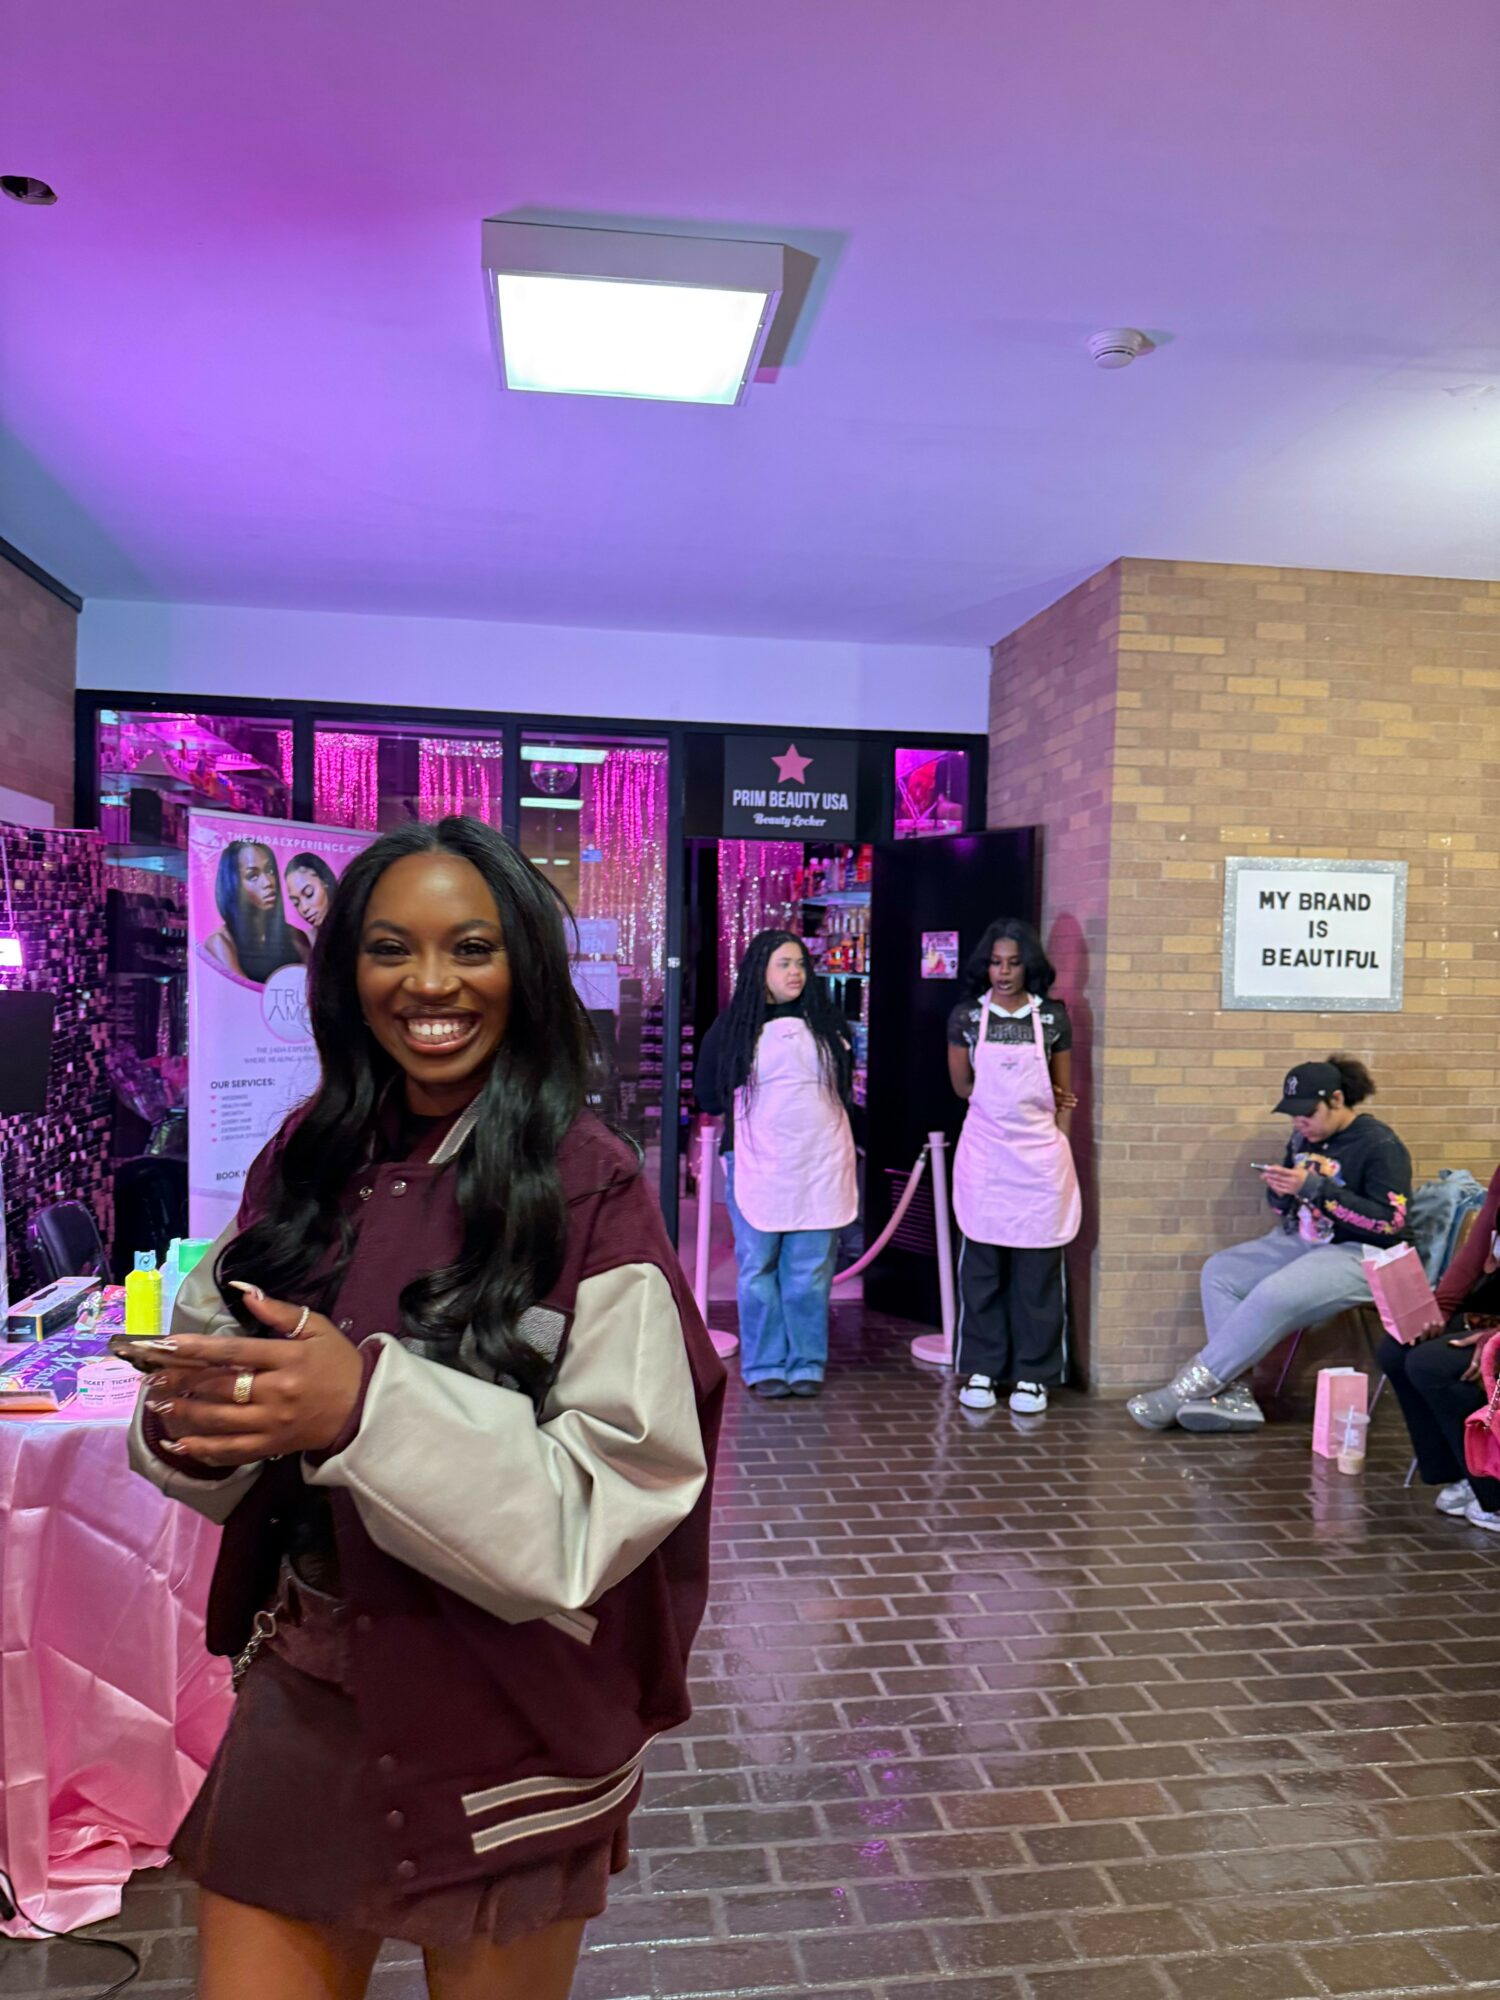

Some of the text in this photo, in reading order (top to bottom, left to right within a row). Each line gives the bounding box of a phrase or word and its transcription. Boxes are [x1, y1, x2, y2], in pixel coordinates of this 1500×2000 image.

[732, 789, 849, 810] PRIM BEAUTY USA
[753, 812, 827, 828] Beauty Locker
[1259, 891, 1371, 911] MY BRAND
[1308, 920, 1328, 939] IS
[1261, 948, 1379, 969] BEAUTIFUL
[210, 1081, 230, 1089] OUR
[216, 1170, 240, 1181] BOOK
[112, 1377, 136, 1385] TICKET
